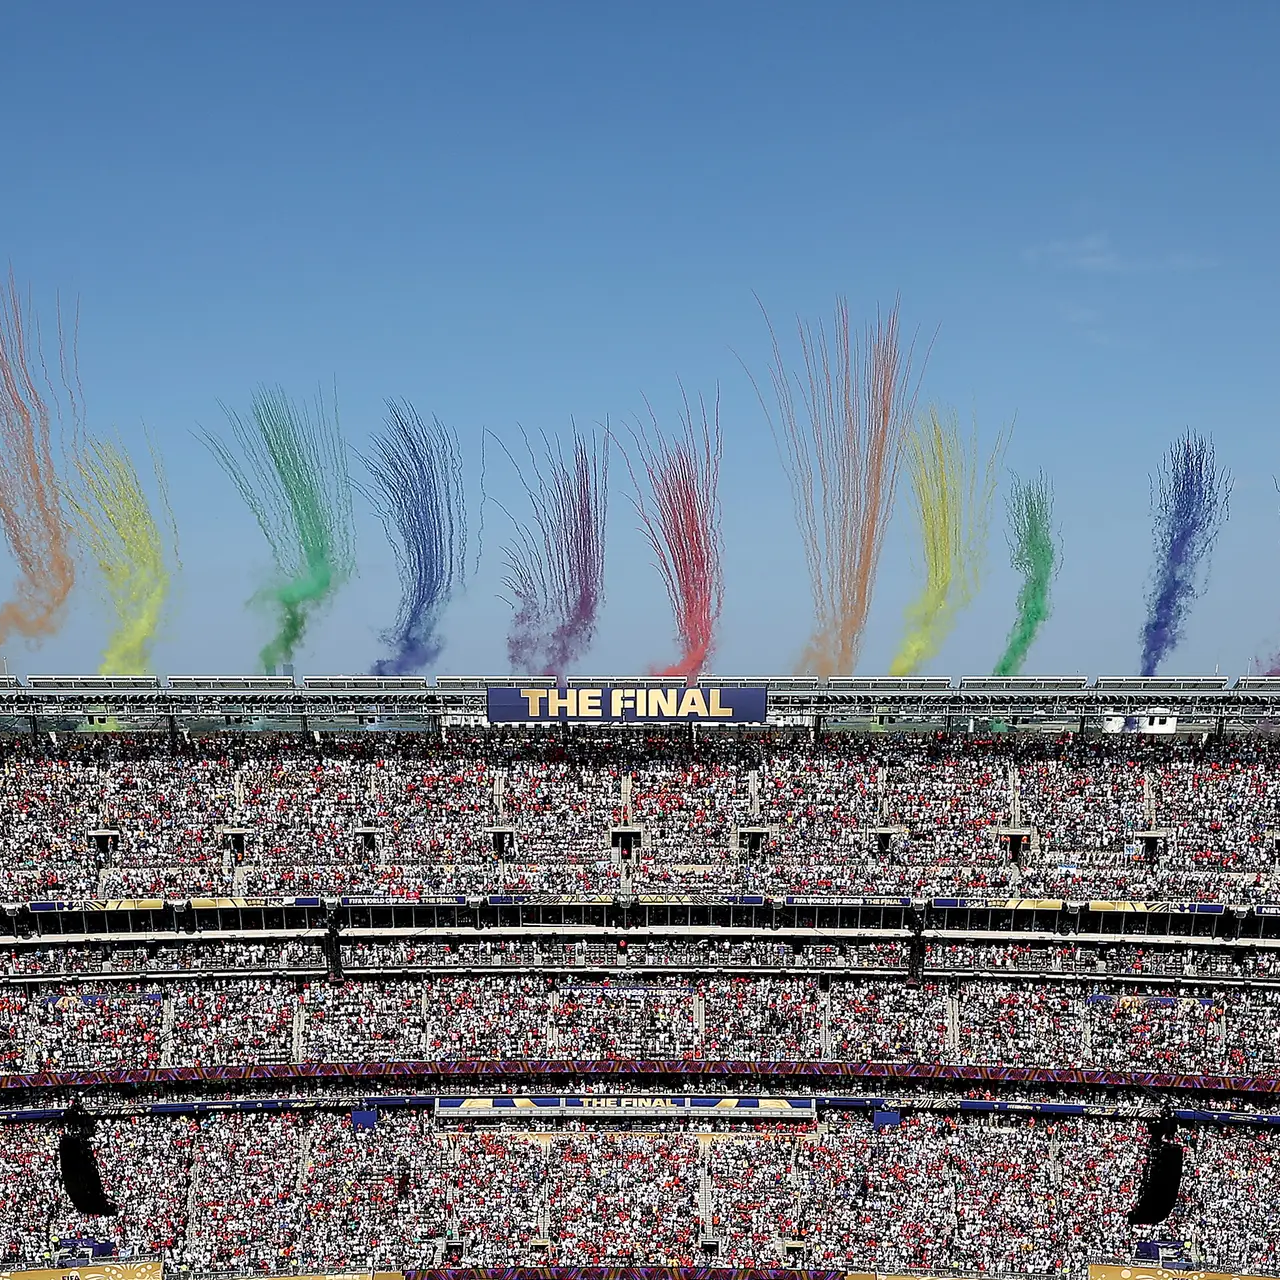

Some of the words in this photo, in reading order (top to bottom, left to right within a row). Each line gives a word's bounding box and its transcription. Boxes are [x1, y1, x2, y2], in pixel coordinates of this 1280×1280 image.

[521, 689, 602, 717] THE
[611, 689, 733, 717] FINAL
[580, 1098, 618, 1108] THE
[622, 1098, 678, 1108] FINAL
